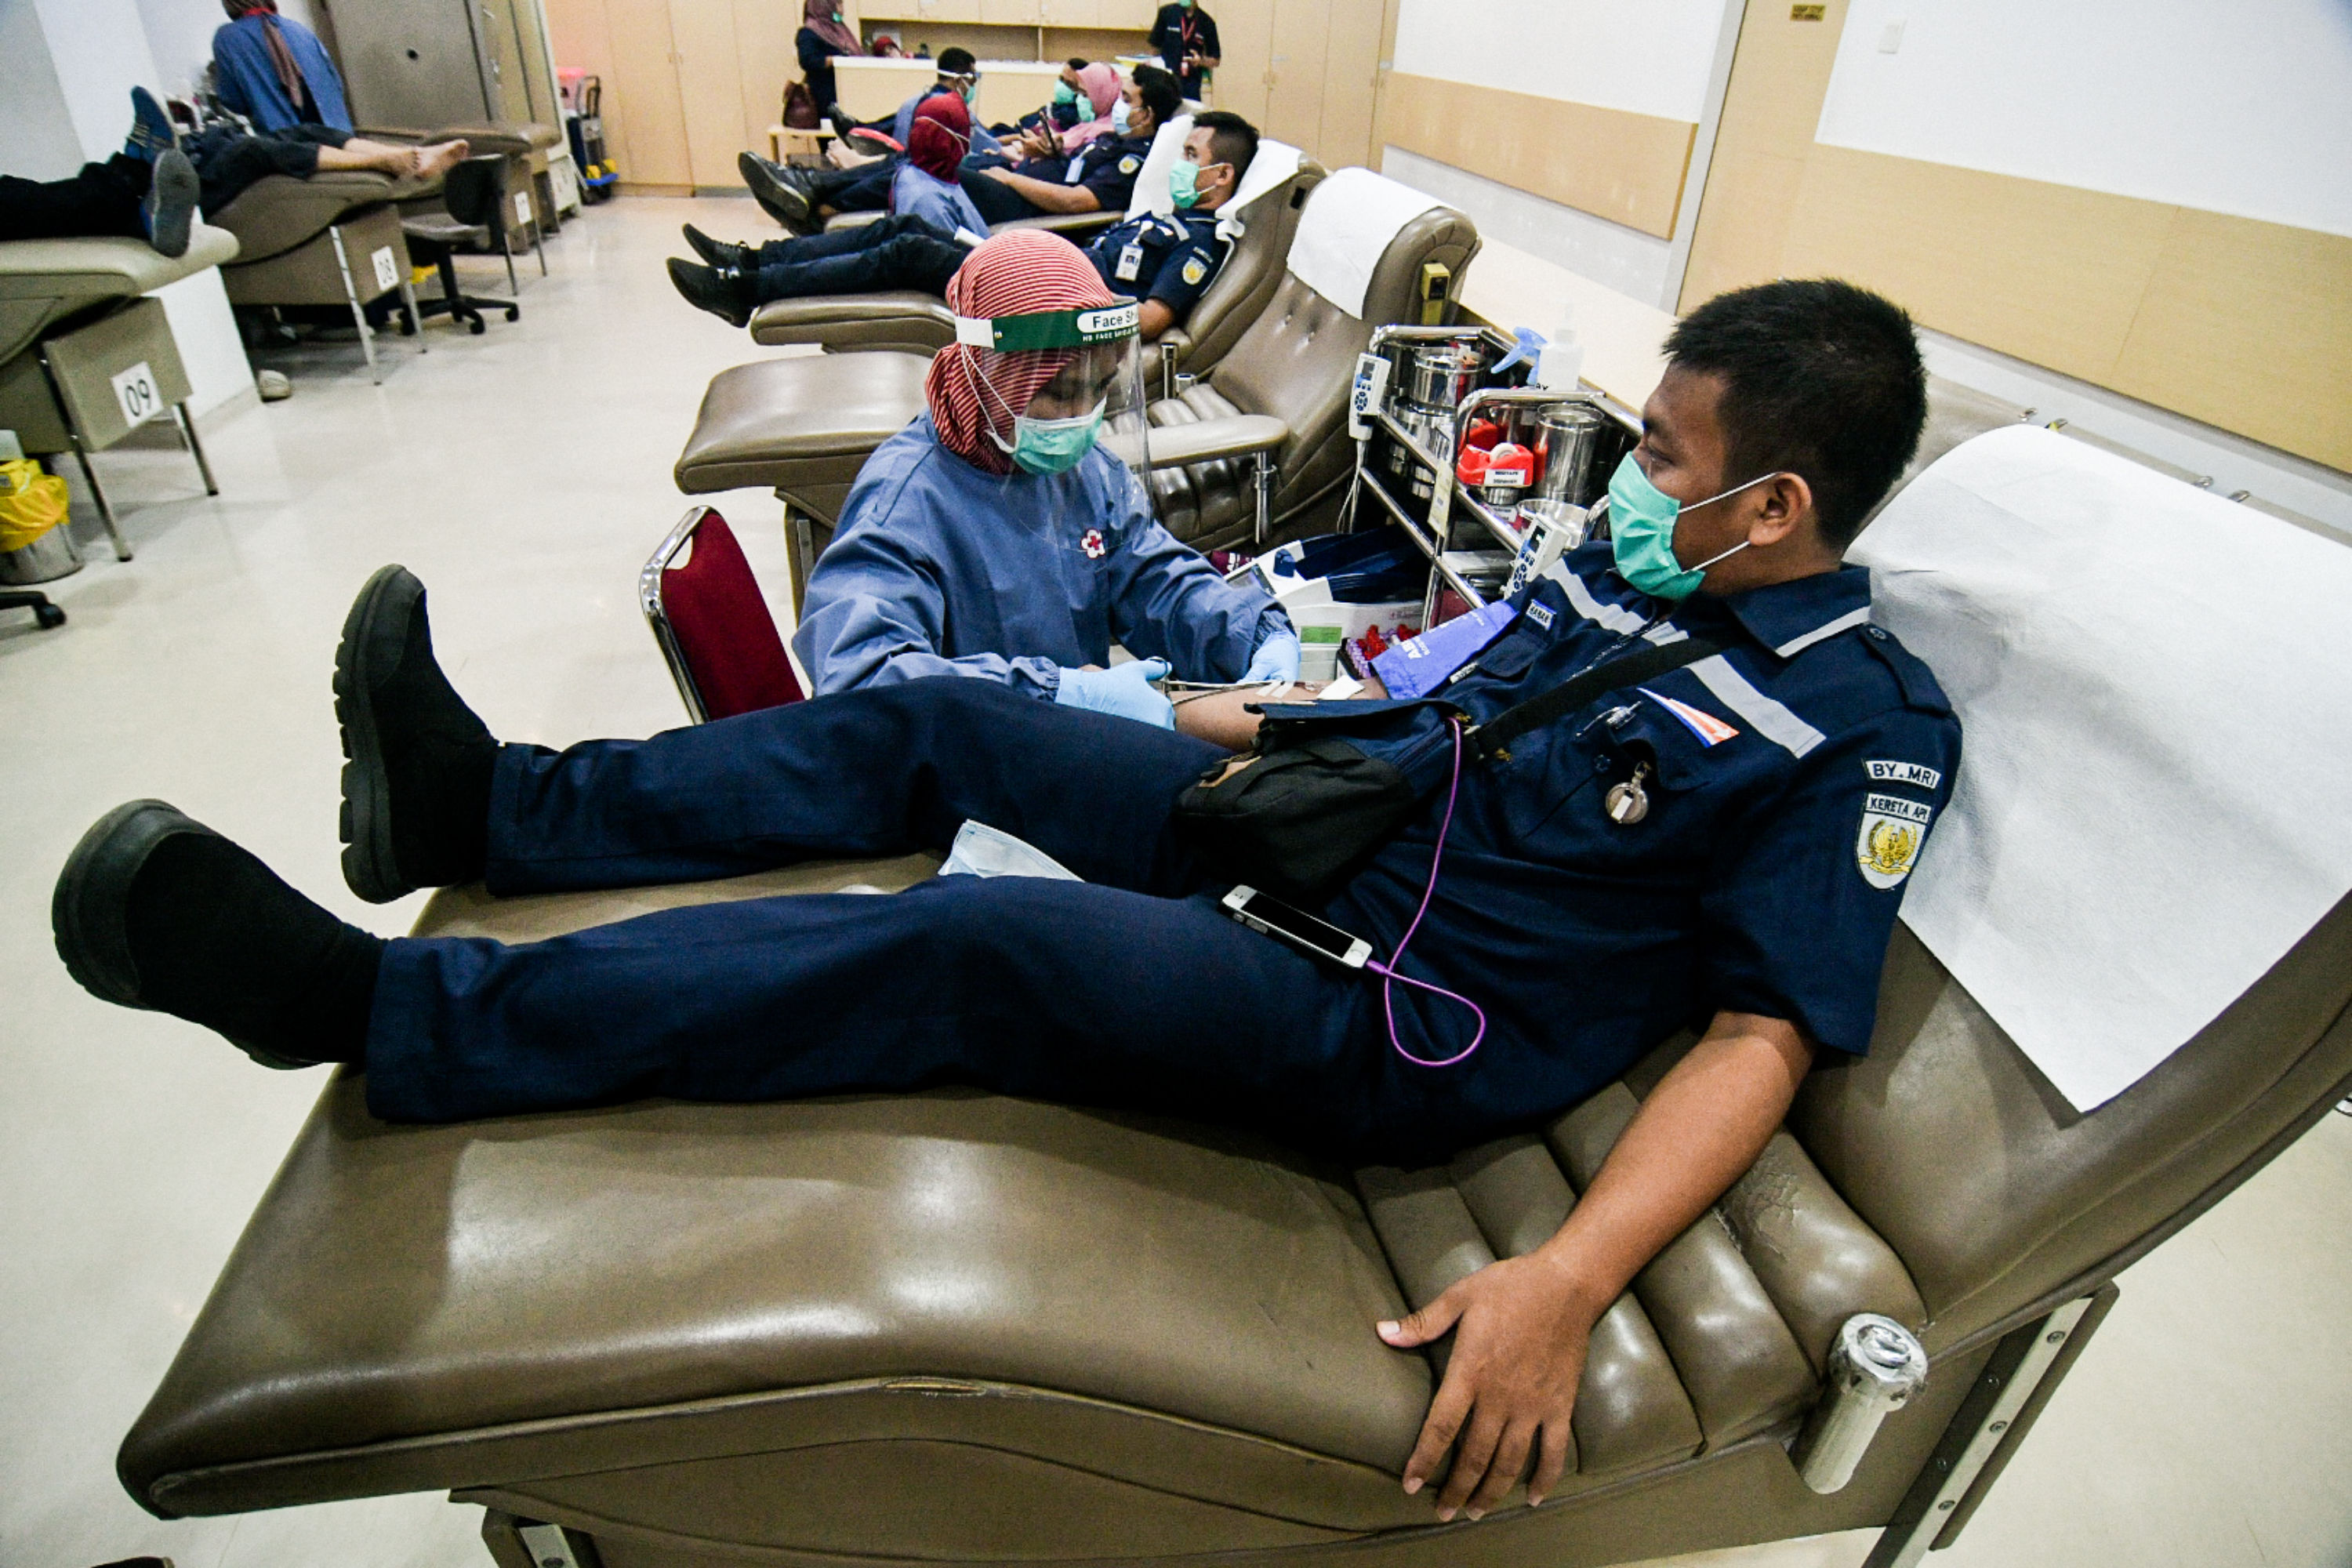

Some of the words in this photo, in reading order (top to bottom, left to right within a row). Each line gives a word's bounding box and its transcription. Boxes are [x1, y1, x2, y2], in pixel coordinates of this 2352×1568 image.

[1093, 315, 1123, 328] Face
[125, 379, 151, 417] 09
[1870, 797, 1909, 815] KERETA
